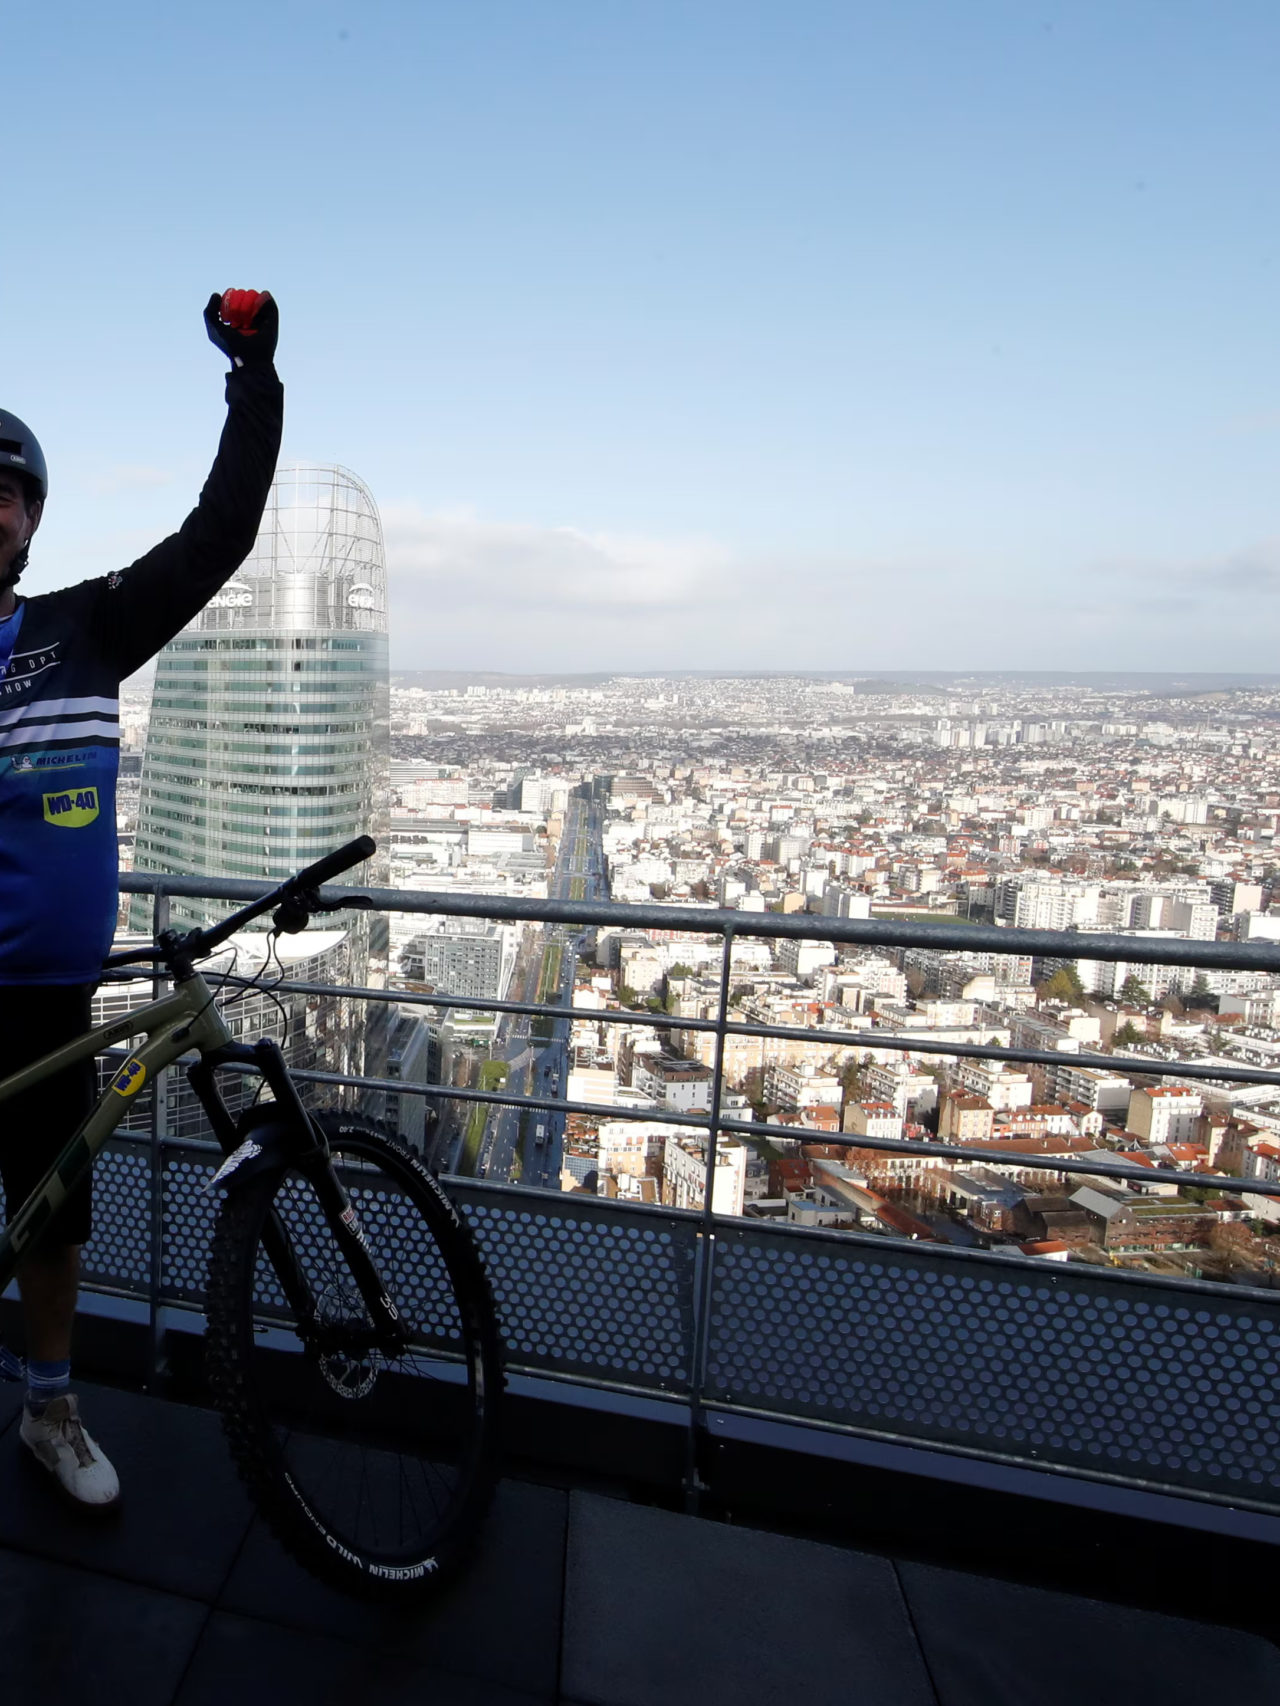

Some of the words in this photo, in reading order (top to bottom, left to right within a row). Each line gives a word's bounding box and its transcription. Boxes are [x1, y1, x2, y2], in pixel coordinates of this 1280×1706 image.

[28, 651, 57, 669] DPT
[36, 751, 97, 766] MICHELIN
[47, 791, 96, 815] WD-40
[369, 1564, 425, 1581] MICHELIN
